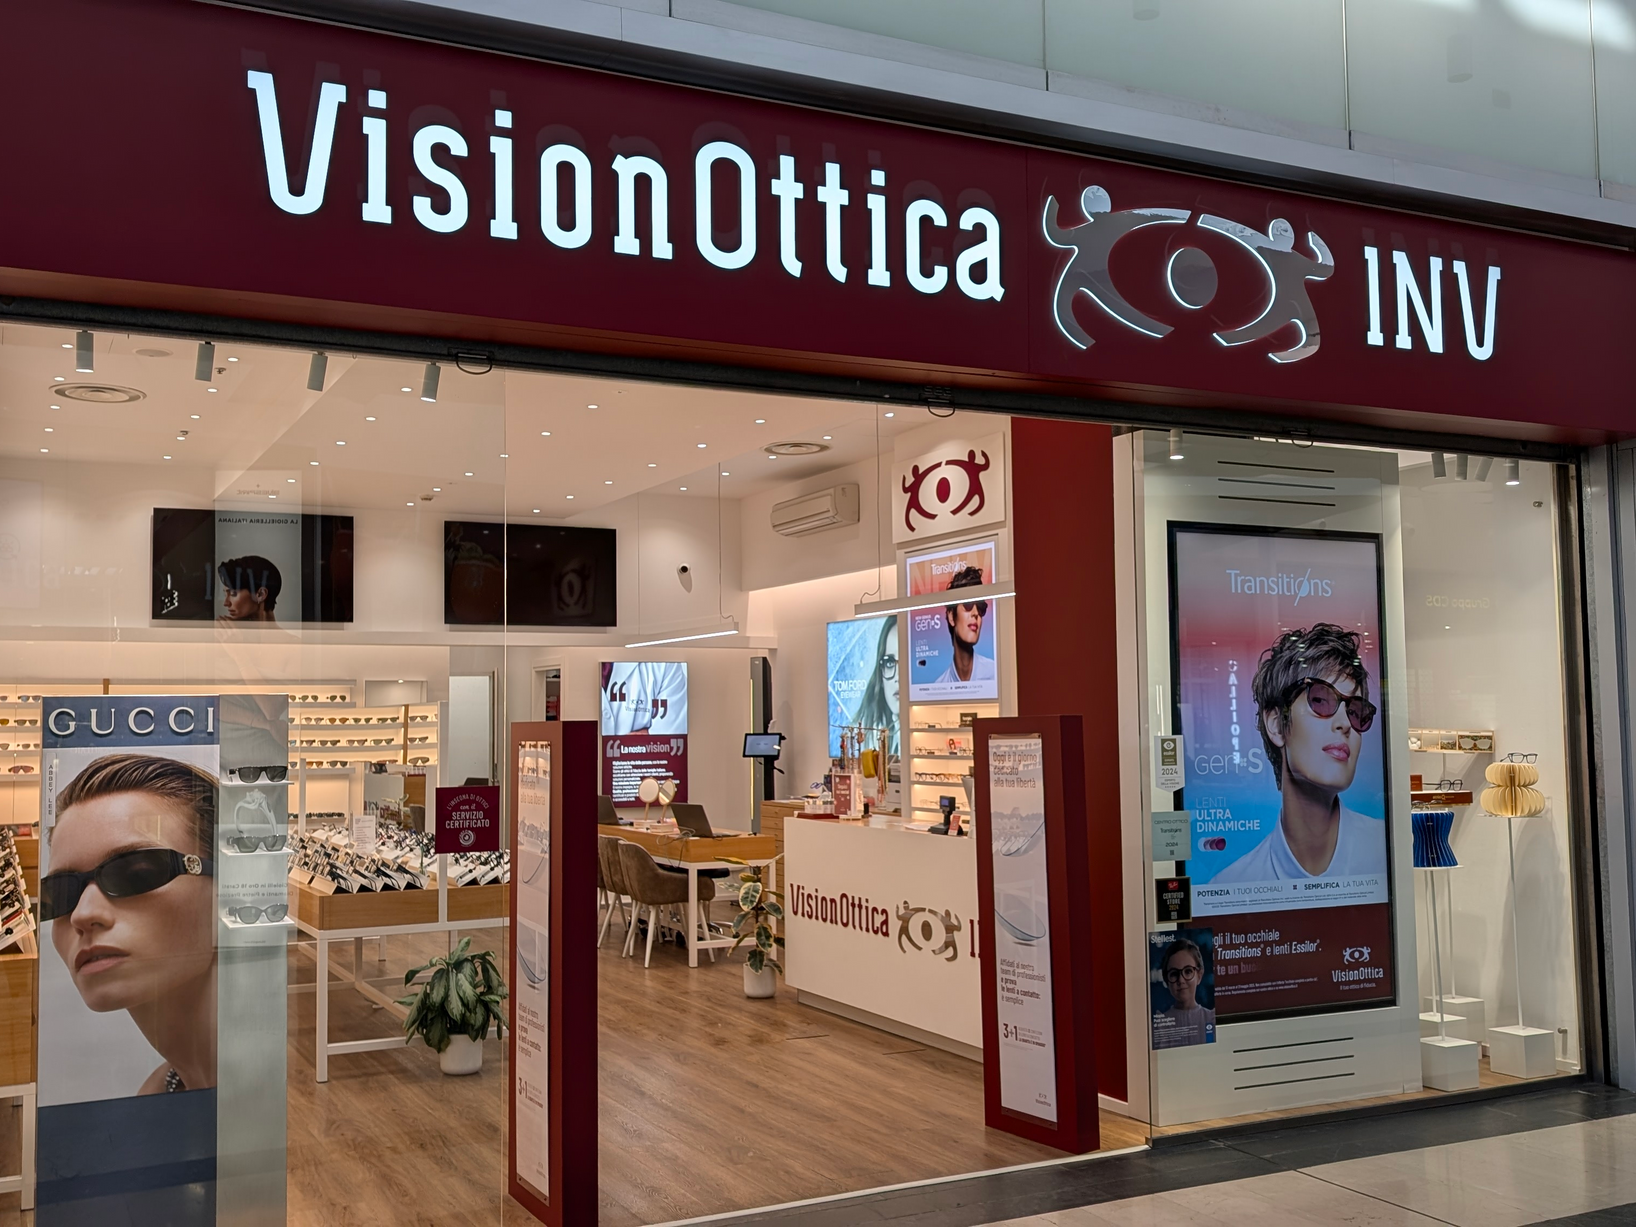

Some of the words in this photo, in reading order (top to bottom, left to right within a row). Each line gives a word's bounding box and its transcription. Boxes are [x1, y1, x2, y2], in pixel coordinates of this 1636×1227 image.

[246, 70, 1005, 303] VisionOttica
[1364, 245, 1502, 362] INV
[931, 557, 967, 576] Transitions
[1226, 568, 1332, 606] Transitions
[833, 680, 848, 692] TOM
[849, 680, 867, 690] FORD
[48, 706, 214, 736] GUCCI
[621, 745, 628, 753] La
[629, 745, 646, 753] nostra
[646, 742, 670, 753] vision
[993, 751, 1007, 764] Oggi
[1017, 751, 1037, 765] giorno
[1161, 767, 1178, 776] 2024
[993, 777, 1004, 788] alla
[1005, 778, 1015, 788] tua
[1016, 777, 1036, 789] libertà
[1195, 796, 1227, 809] LENTI
[451, 810, 484, 820] SERVIZIO
[1196, 808, 1232, 821] ULTRA
[445, 819, 490, 829] CERTIFICATO
[1196, 819, 1261, 833] DINAMICHE
[1197, 889, 1231, 898] POTENZIA
[1236, 887, 1253, 895] TUOI
[1253, 885, 1284, 894] OCCHIALI
[1303, 881, 1340, 891] SEMPLIFICA
[1342, 880, 1351, 888] LA
[1351, 880, 1364, 888] TUA
[1364, 879, 1379, 887] VITA
[789, 883, 890, 938] VisionOttica
[1212, 932, 1223, 949] gli
[1225, 932, 1231, 945] il
[1232, 932, 1245, 944] tuo
[1247, 928, 1280, 943] occhiale
[1266, 946, 1271, 956] e
[1273, 942, 1290, 955] lenti
[1216, 964, 1226, 976] te
[1228, 965, 1239, 975] un
[1332, 966, 1384, 983] VisionOttica
[1003, 1022, 1018, 1042] 3+1
[518, 1076, 528, 1099] 3+1
